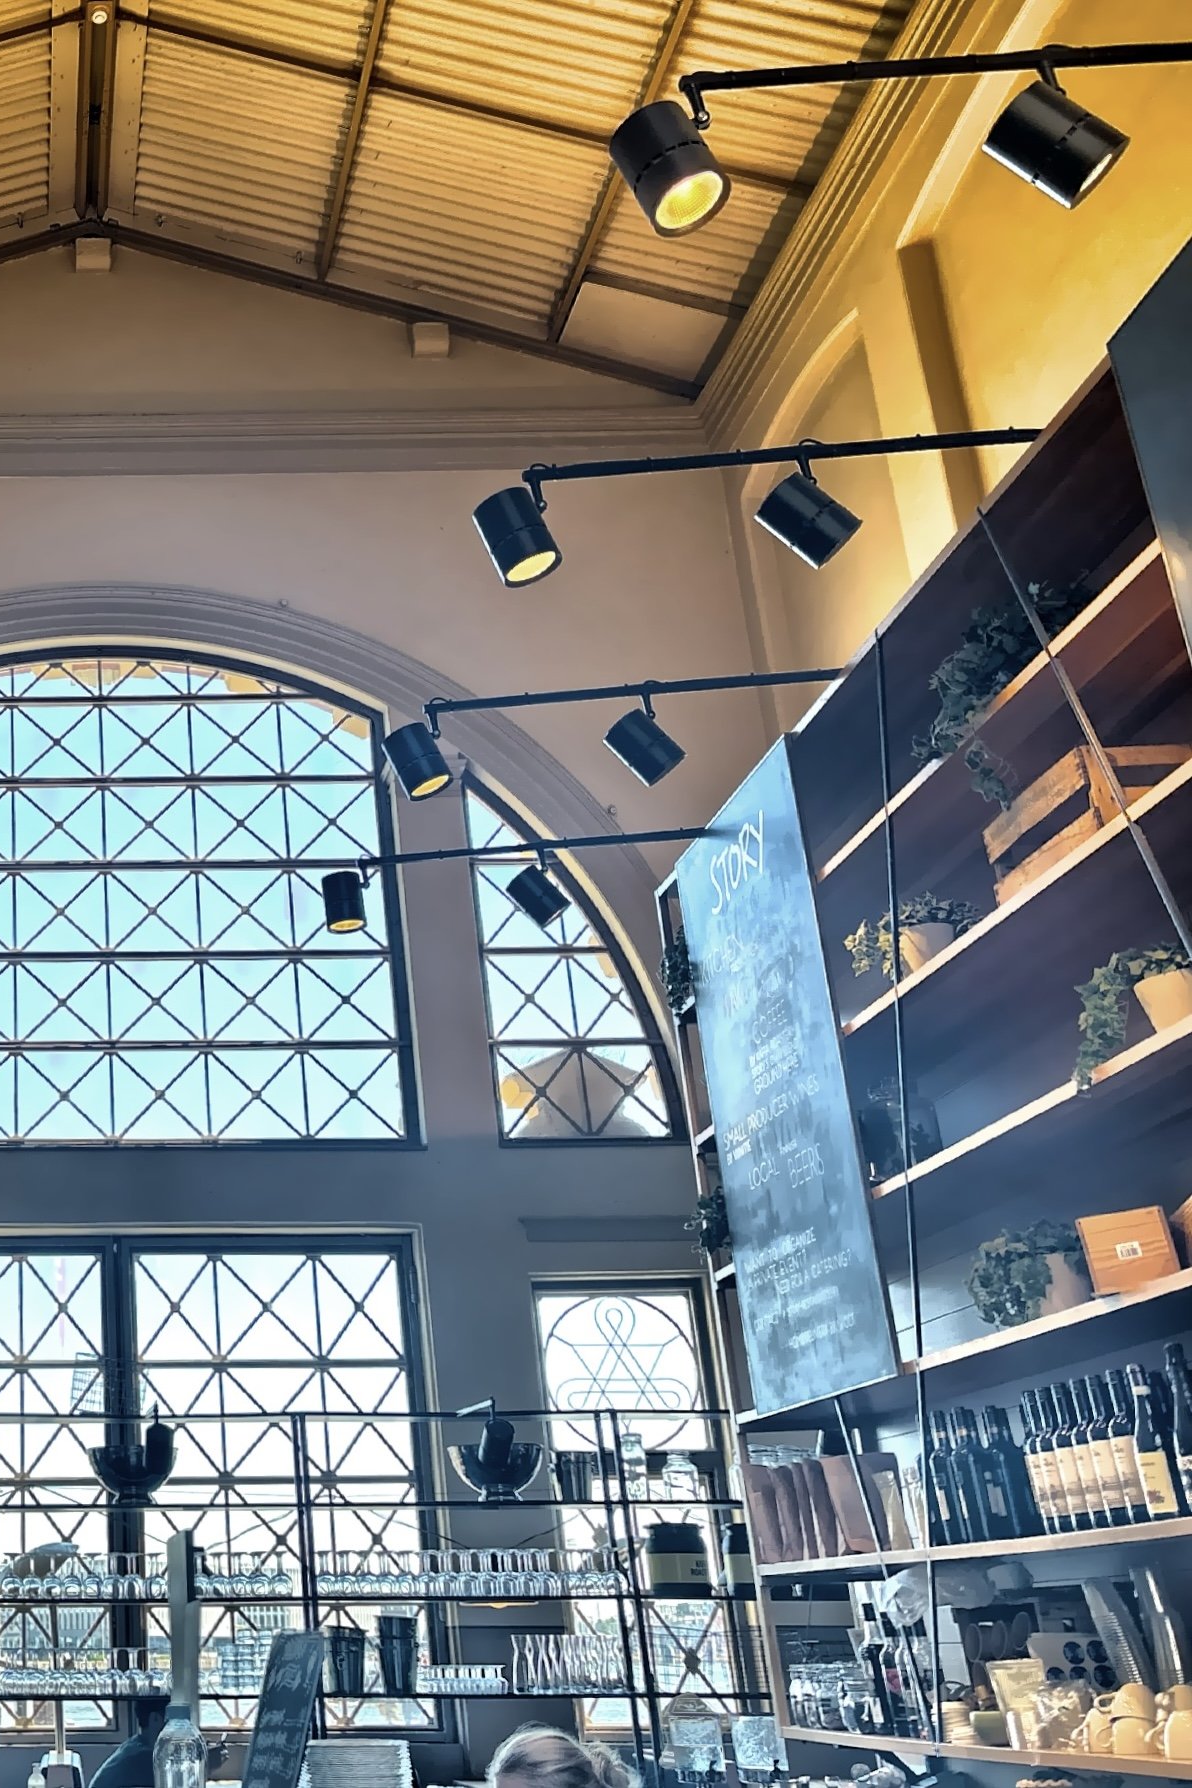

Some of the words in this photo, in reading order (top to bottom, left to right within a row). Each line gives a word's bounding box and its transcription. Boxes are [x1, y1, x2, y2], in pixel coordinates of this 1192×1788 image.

[711, 810, 765, 915] STORY
[723, 1123, 747, 1151] SMALL
[748, 1095, 788, 1133] PRODUCER
[789, 1073, 819, 1106] WINES
[748, 1157, 780, 1190] LOCAL
[787, 1143, 824, 1188] BEERS
[811, 1248, 852, 1279] CATERING?
